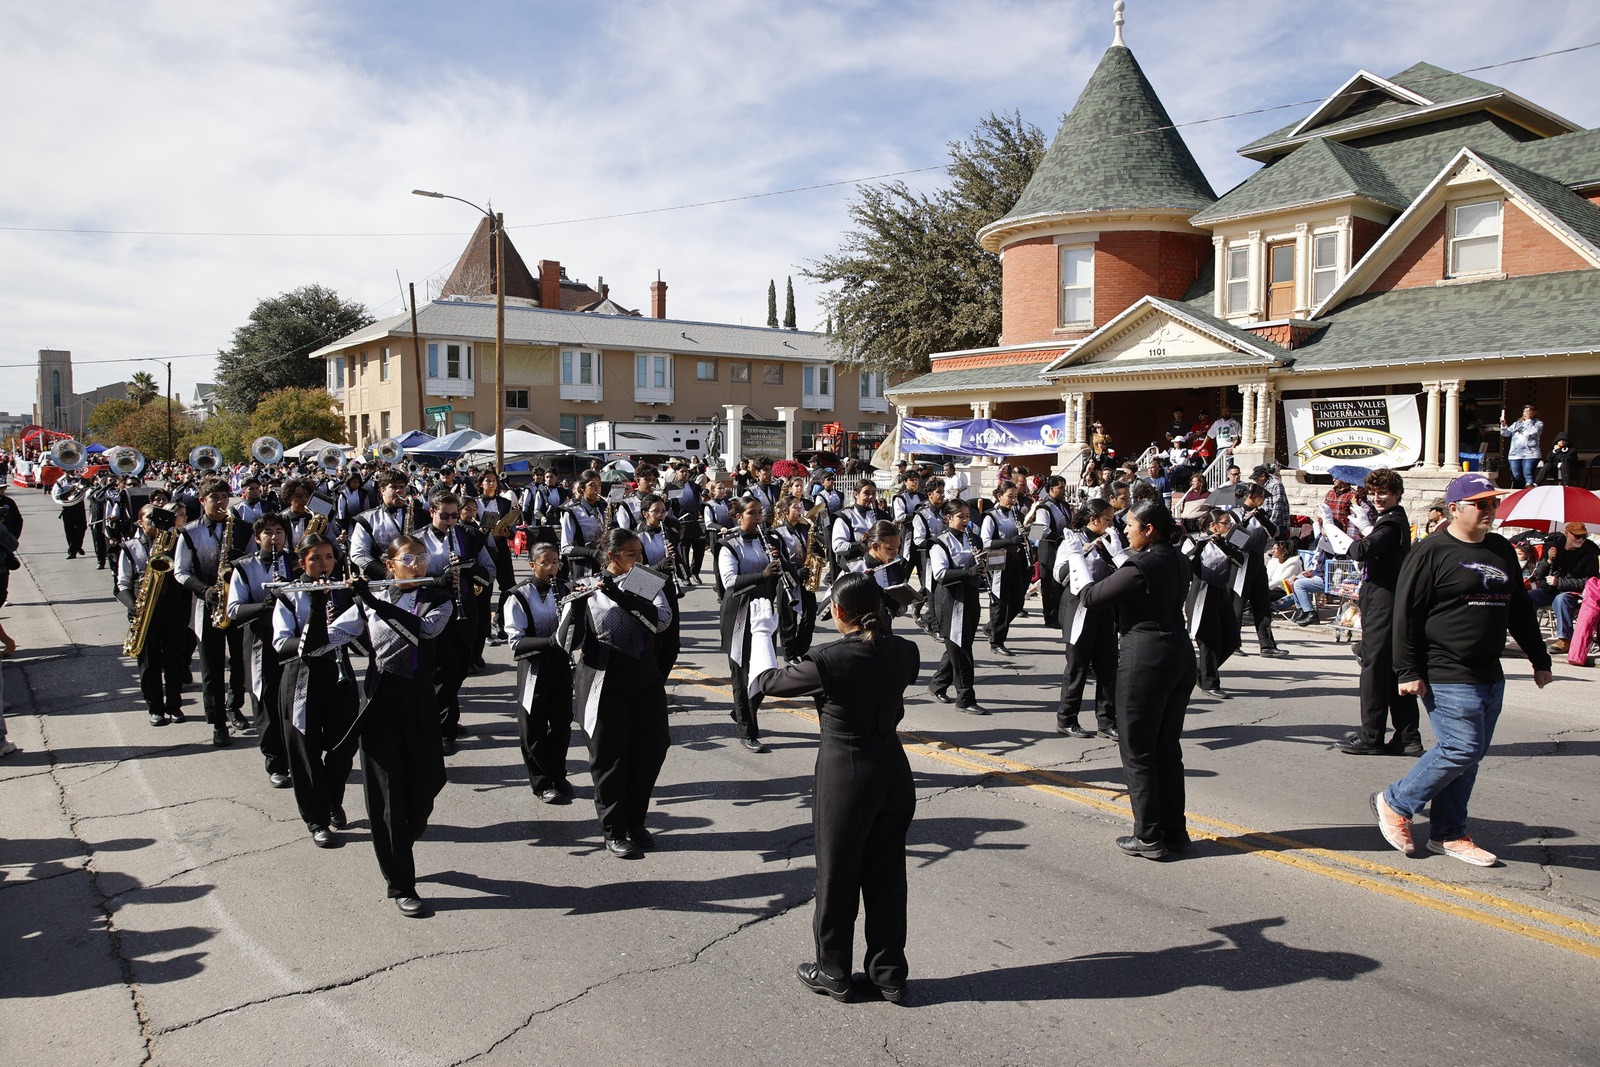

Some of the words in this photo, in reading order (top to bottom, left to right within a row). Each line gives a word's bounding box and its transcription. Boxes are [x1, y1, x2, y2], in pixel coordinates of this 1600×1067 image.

[1149, 348, 1166, 356] 1101
[1357, 401, 1385, 409] VALLES
[1316, 420, 1346, 428] INJURY
[1218, 426, 1230, 438] 12
[975, 432, 1006, 444] KTSM
[1322, 437, 1343, 445] SUN
[1330, 448, 1374, 456] PARADE
